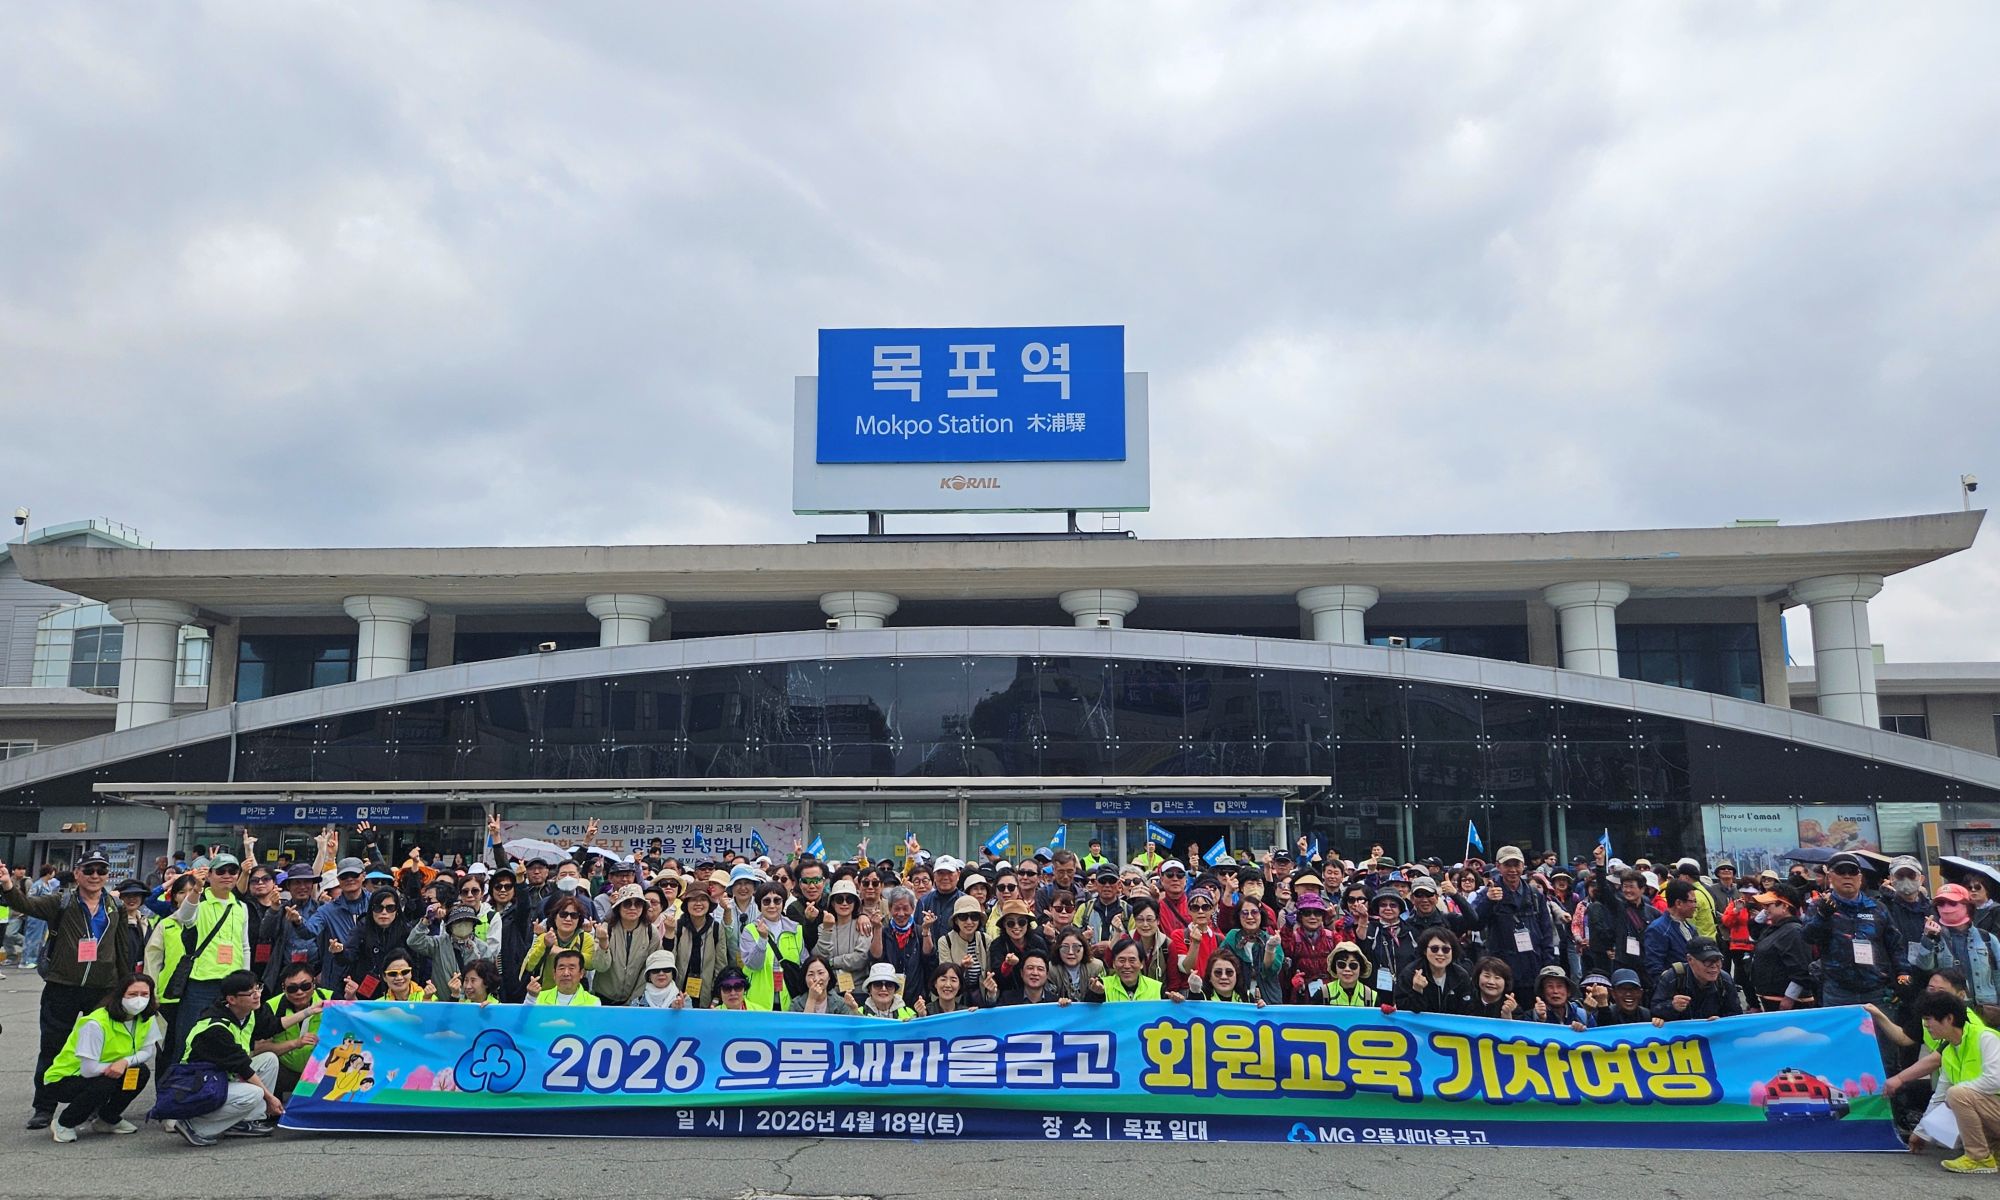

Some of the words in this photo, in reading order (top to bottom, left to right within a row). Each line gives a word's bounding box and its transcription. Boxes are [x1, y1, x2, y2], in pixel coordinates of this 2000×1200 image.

[872, 342, 1070, 402] 목포역
[855, 414, 932, 439] Mokpo
[938, 413, 1013, 434] Station
[1027, 412, 1086, 433] 木浦驛
[940, 475, 1000, 490] KORAIL
[562, 825, 579, 834] 대전
[601, 824, 664, 834] 으뜸새마을금고
[666, 824, 692, 834] 상반기
[715, 824, 742, 833] 교육팀
[544, 1036, 701, 1091] 2026
[717, 1032, 1115, 1089] 으뜸새마을금고
[1141, 1020, 1414, 1098] 회원교육
[1432, 1035, 1713, 1099] 기차여행
[756, 1110, 835, 1133] 2026년
[841, 1111, 875, 1132] 4월
[881, 1112, 964, 1136] 18일(토)
[1123, 1119, 1163, 1140] 목포
[1168, 1120, 1208, 1140] 일대
[1319, 1127, 1355, 1142] MG
[1362, 1128, 1489, 1144] 으뜸새마을금고
